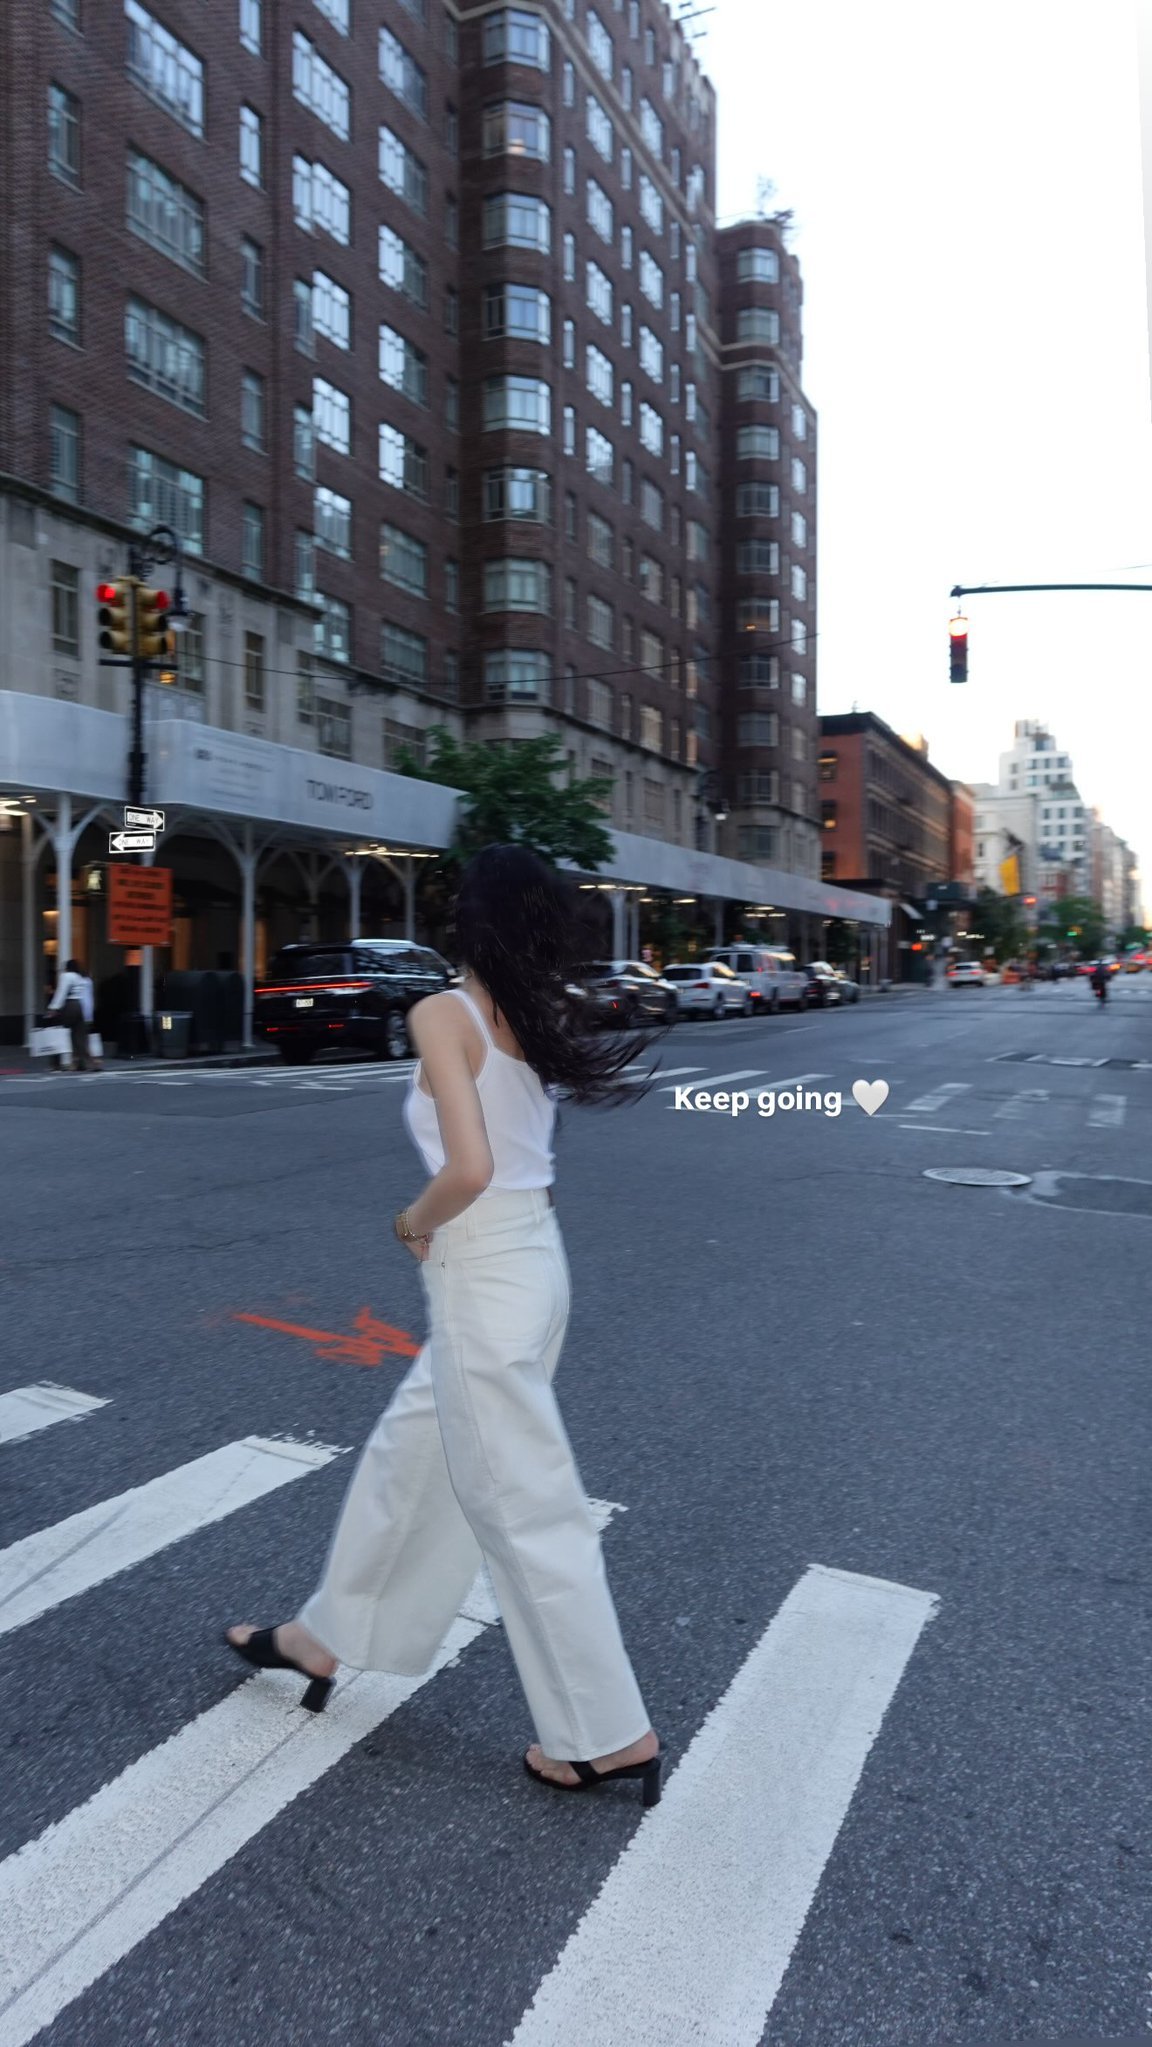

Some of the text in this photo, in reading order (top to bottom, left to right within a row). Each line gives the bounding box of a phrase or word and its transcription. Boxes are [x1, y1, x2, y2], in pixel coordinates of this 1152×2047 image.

[306, 780, 374, 810] TOM FORD
[128, 813, 141, 822] ONE
[146, 816, 159, 825] WAY
[136, 838, 149, 846] WAY
